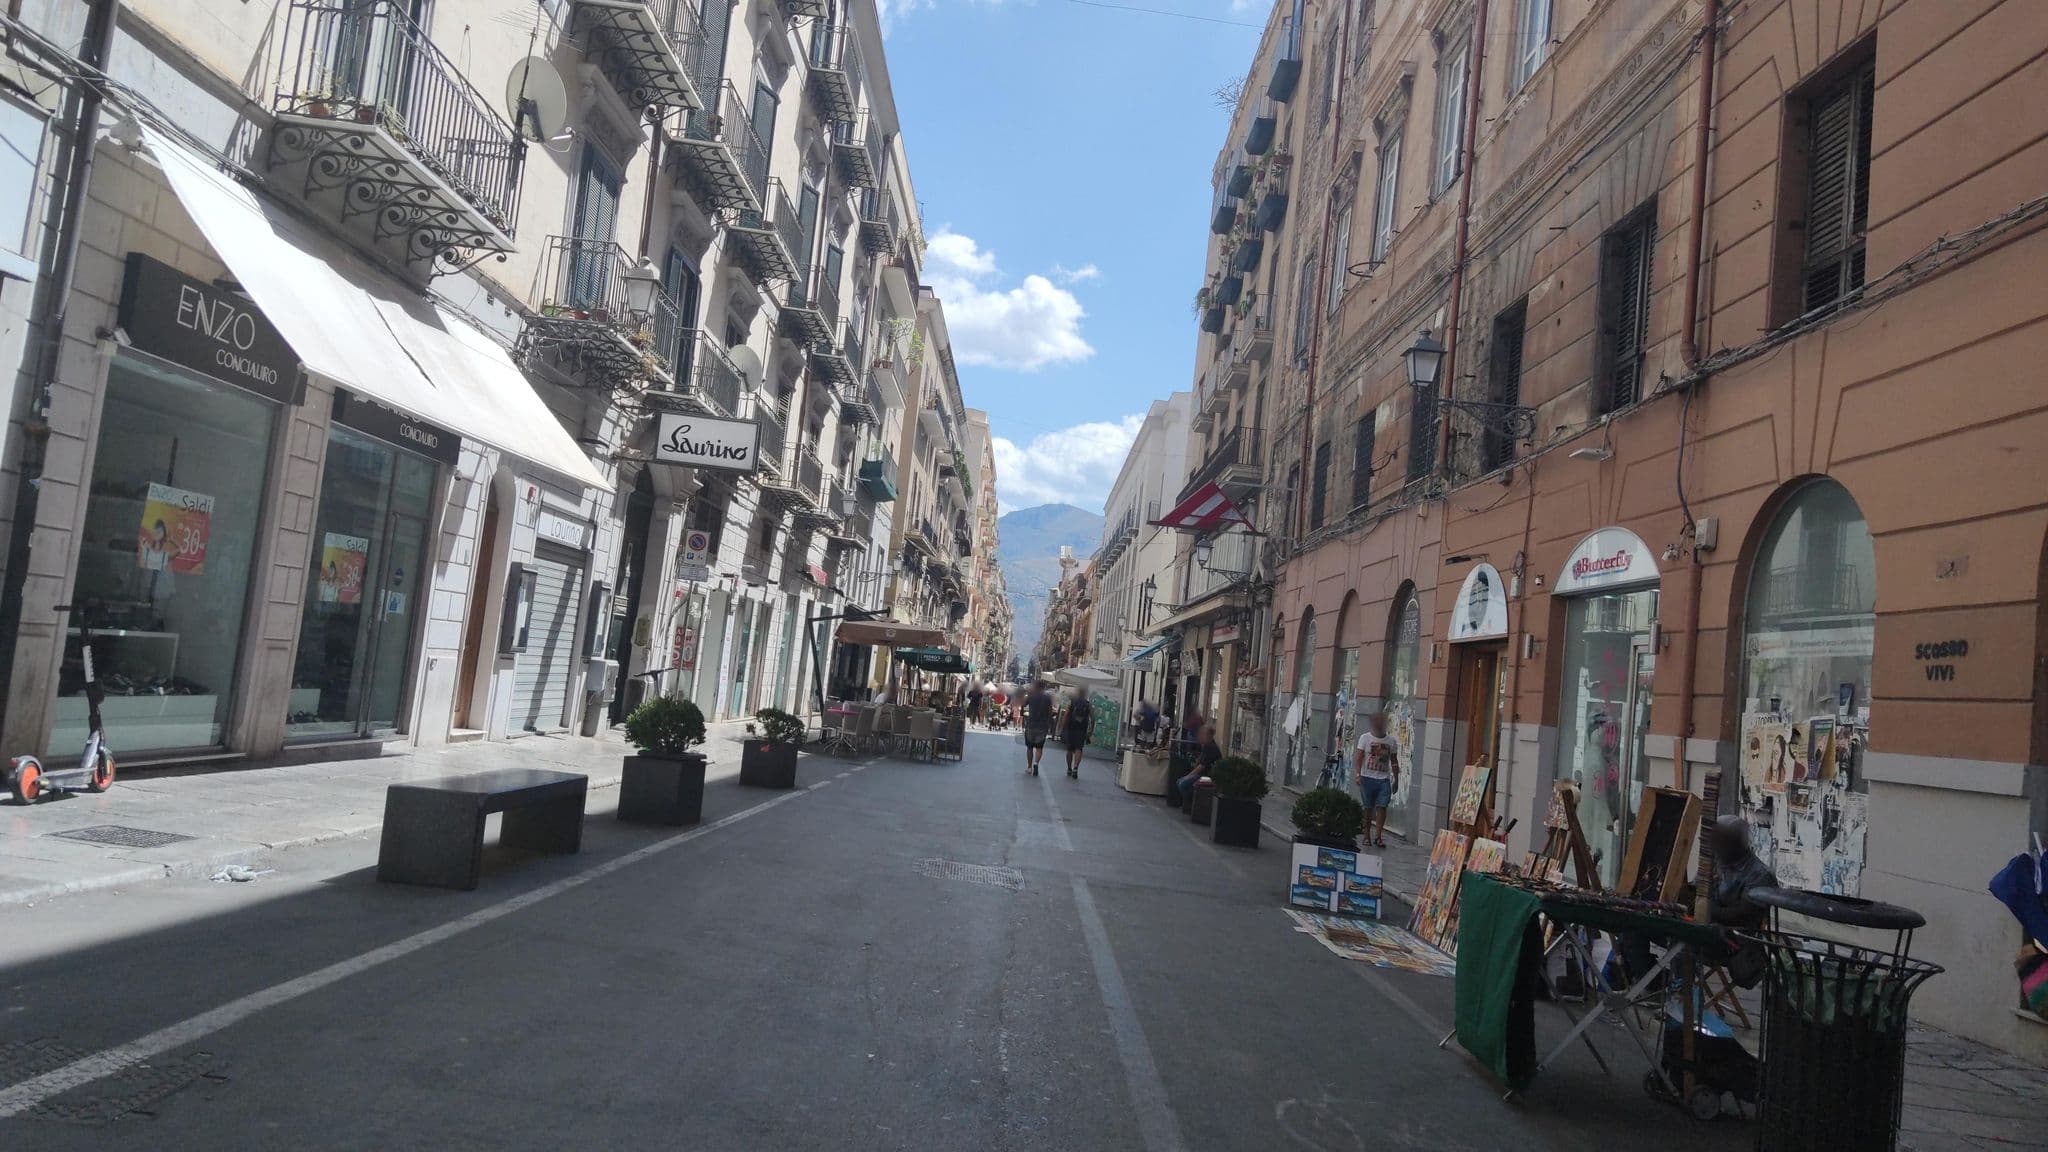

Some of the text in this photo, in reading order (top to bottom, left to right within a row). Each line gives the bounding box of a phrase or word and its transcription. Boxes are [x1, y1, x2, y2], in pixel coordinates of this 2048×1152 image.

[177, 284, 255, 350] ENZO
[216, 348, 278, 385] CONCIAURO
[400, 423, 438, 449] CONCIAURO
[661, 424, 748, 461] Laurino
[182, 494, 213, 514] Saldi
[1580, 549, 1633, 575] Butterfly
